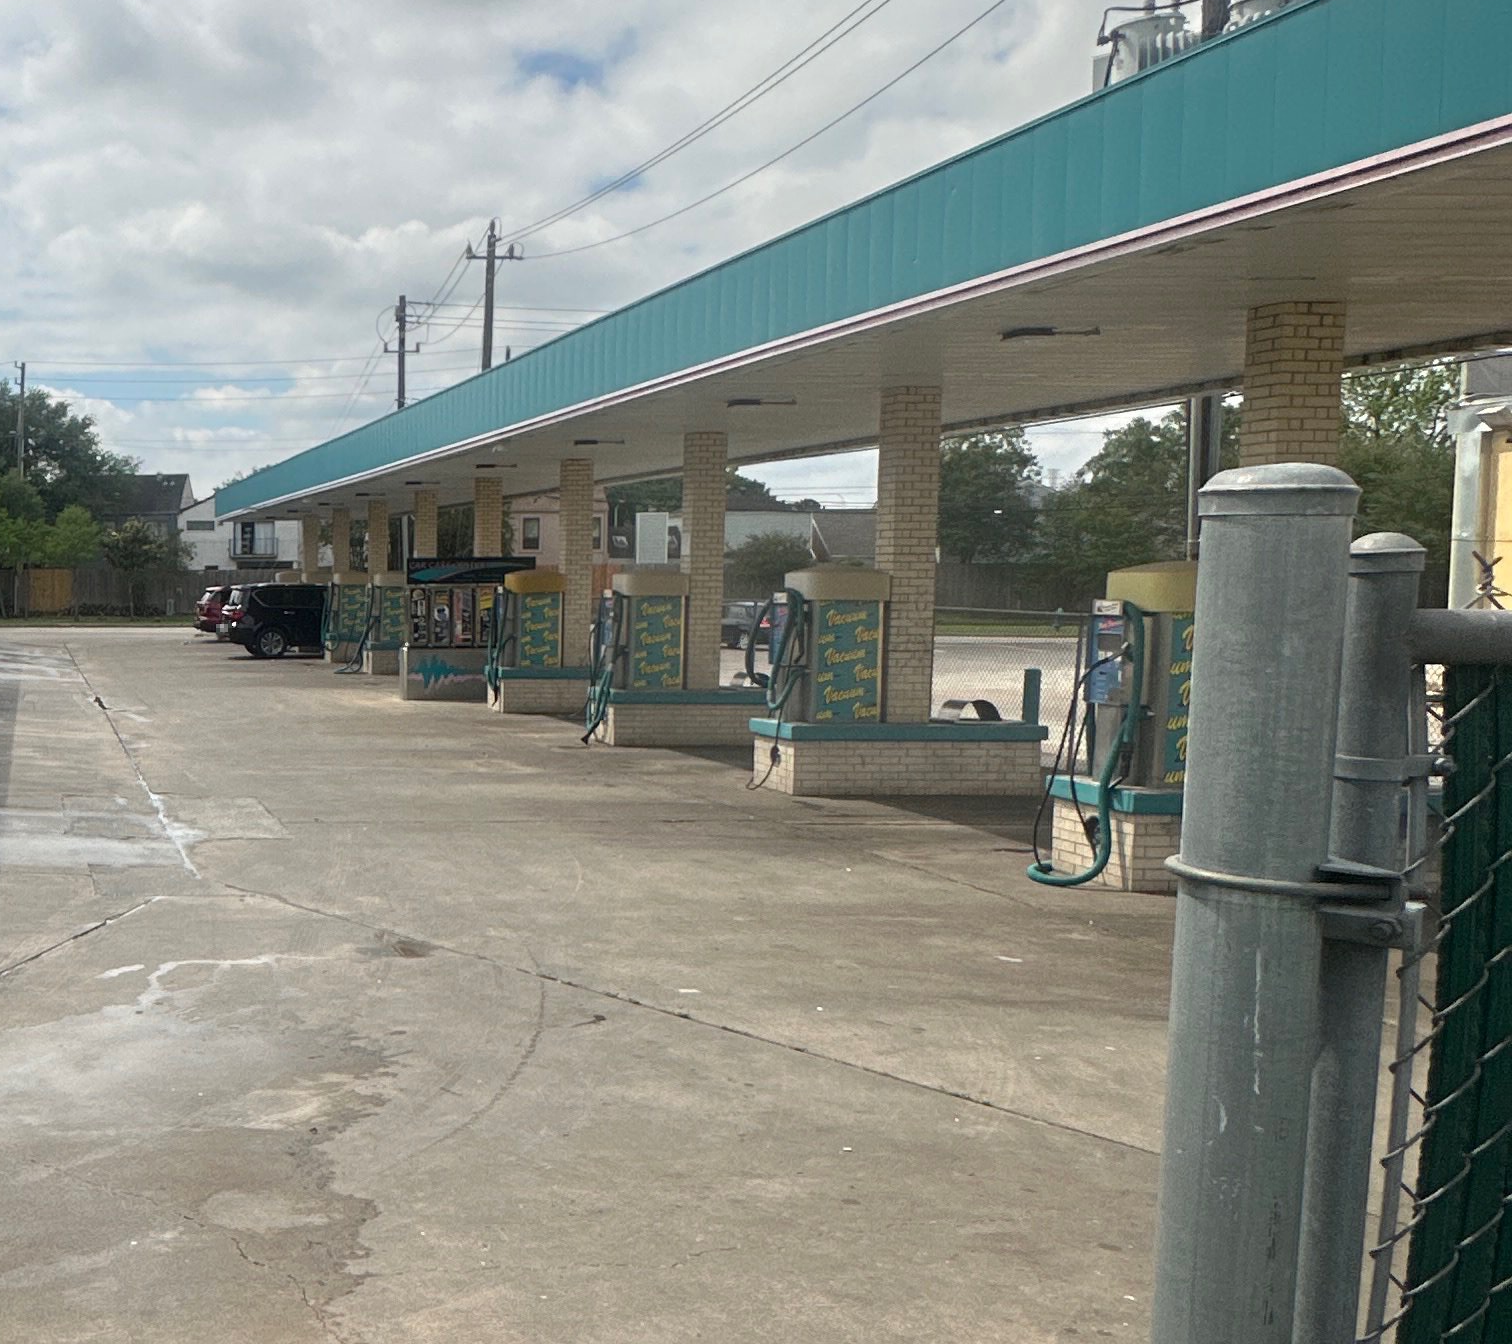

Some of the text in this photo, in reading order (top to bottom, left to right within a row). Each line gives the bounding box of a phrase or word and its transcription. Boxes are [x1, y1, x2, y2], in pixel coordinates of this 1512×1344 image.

[826, 609, 867, 626] Vacuum
[825, 648, 866, 665] Vacuum
[824, 685, 864, 704] Vacuum
